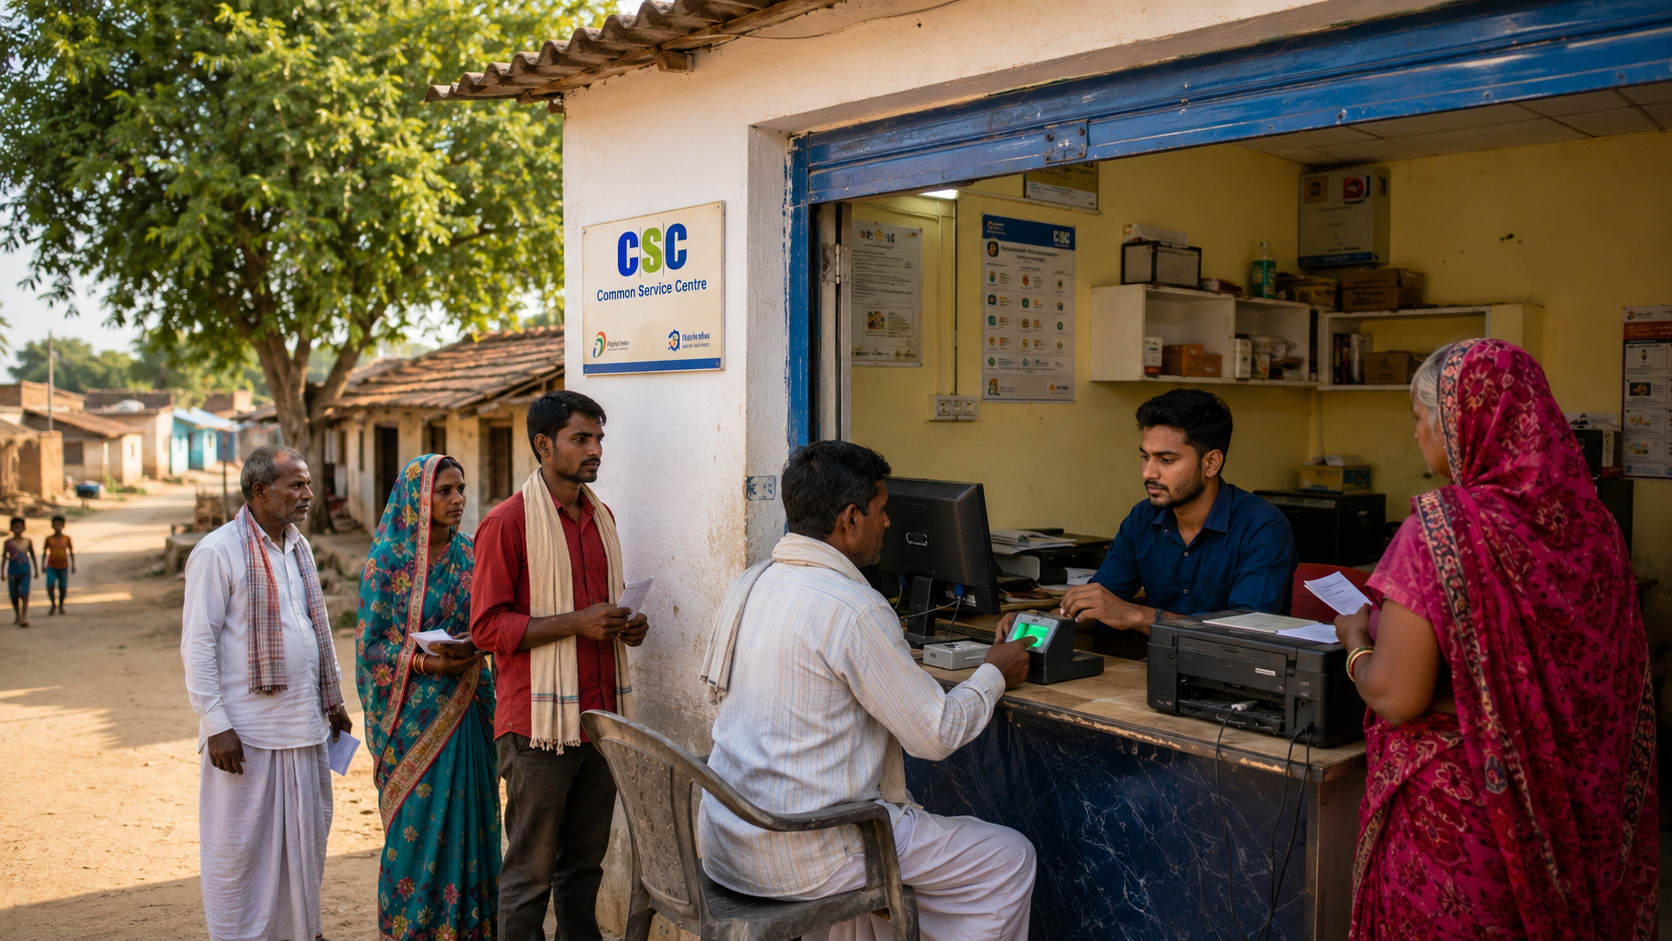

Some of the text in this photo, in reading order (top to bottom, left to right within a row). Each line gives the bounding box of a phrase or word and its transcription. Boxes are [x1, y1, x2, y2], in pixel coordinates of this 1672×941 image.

[617, 223, 687, 277] CSC
[597, 278, 707, 302] Common Service Centre
